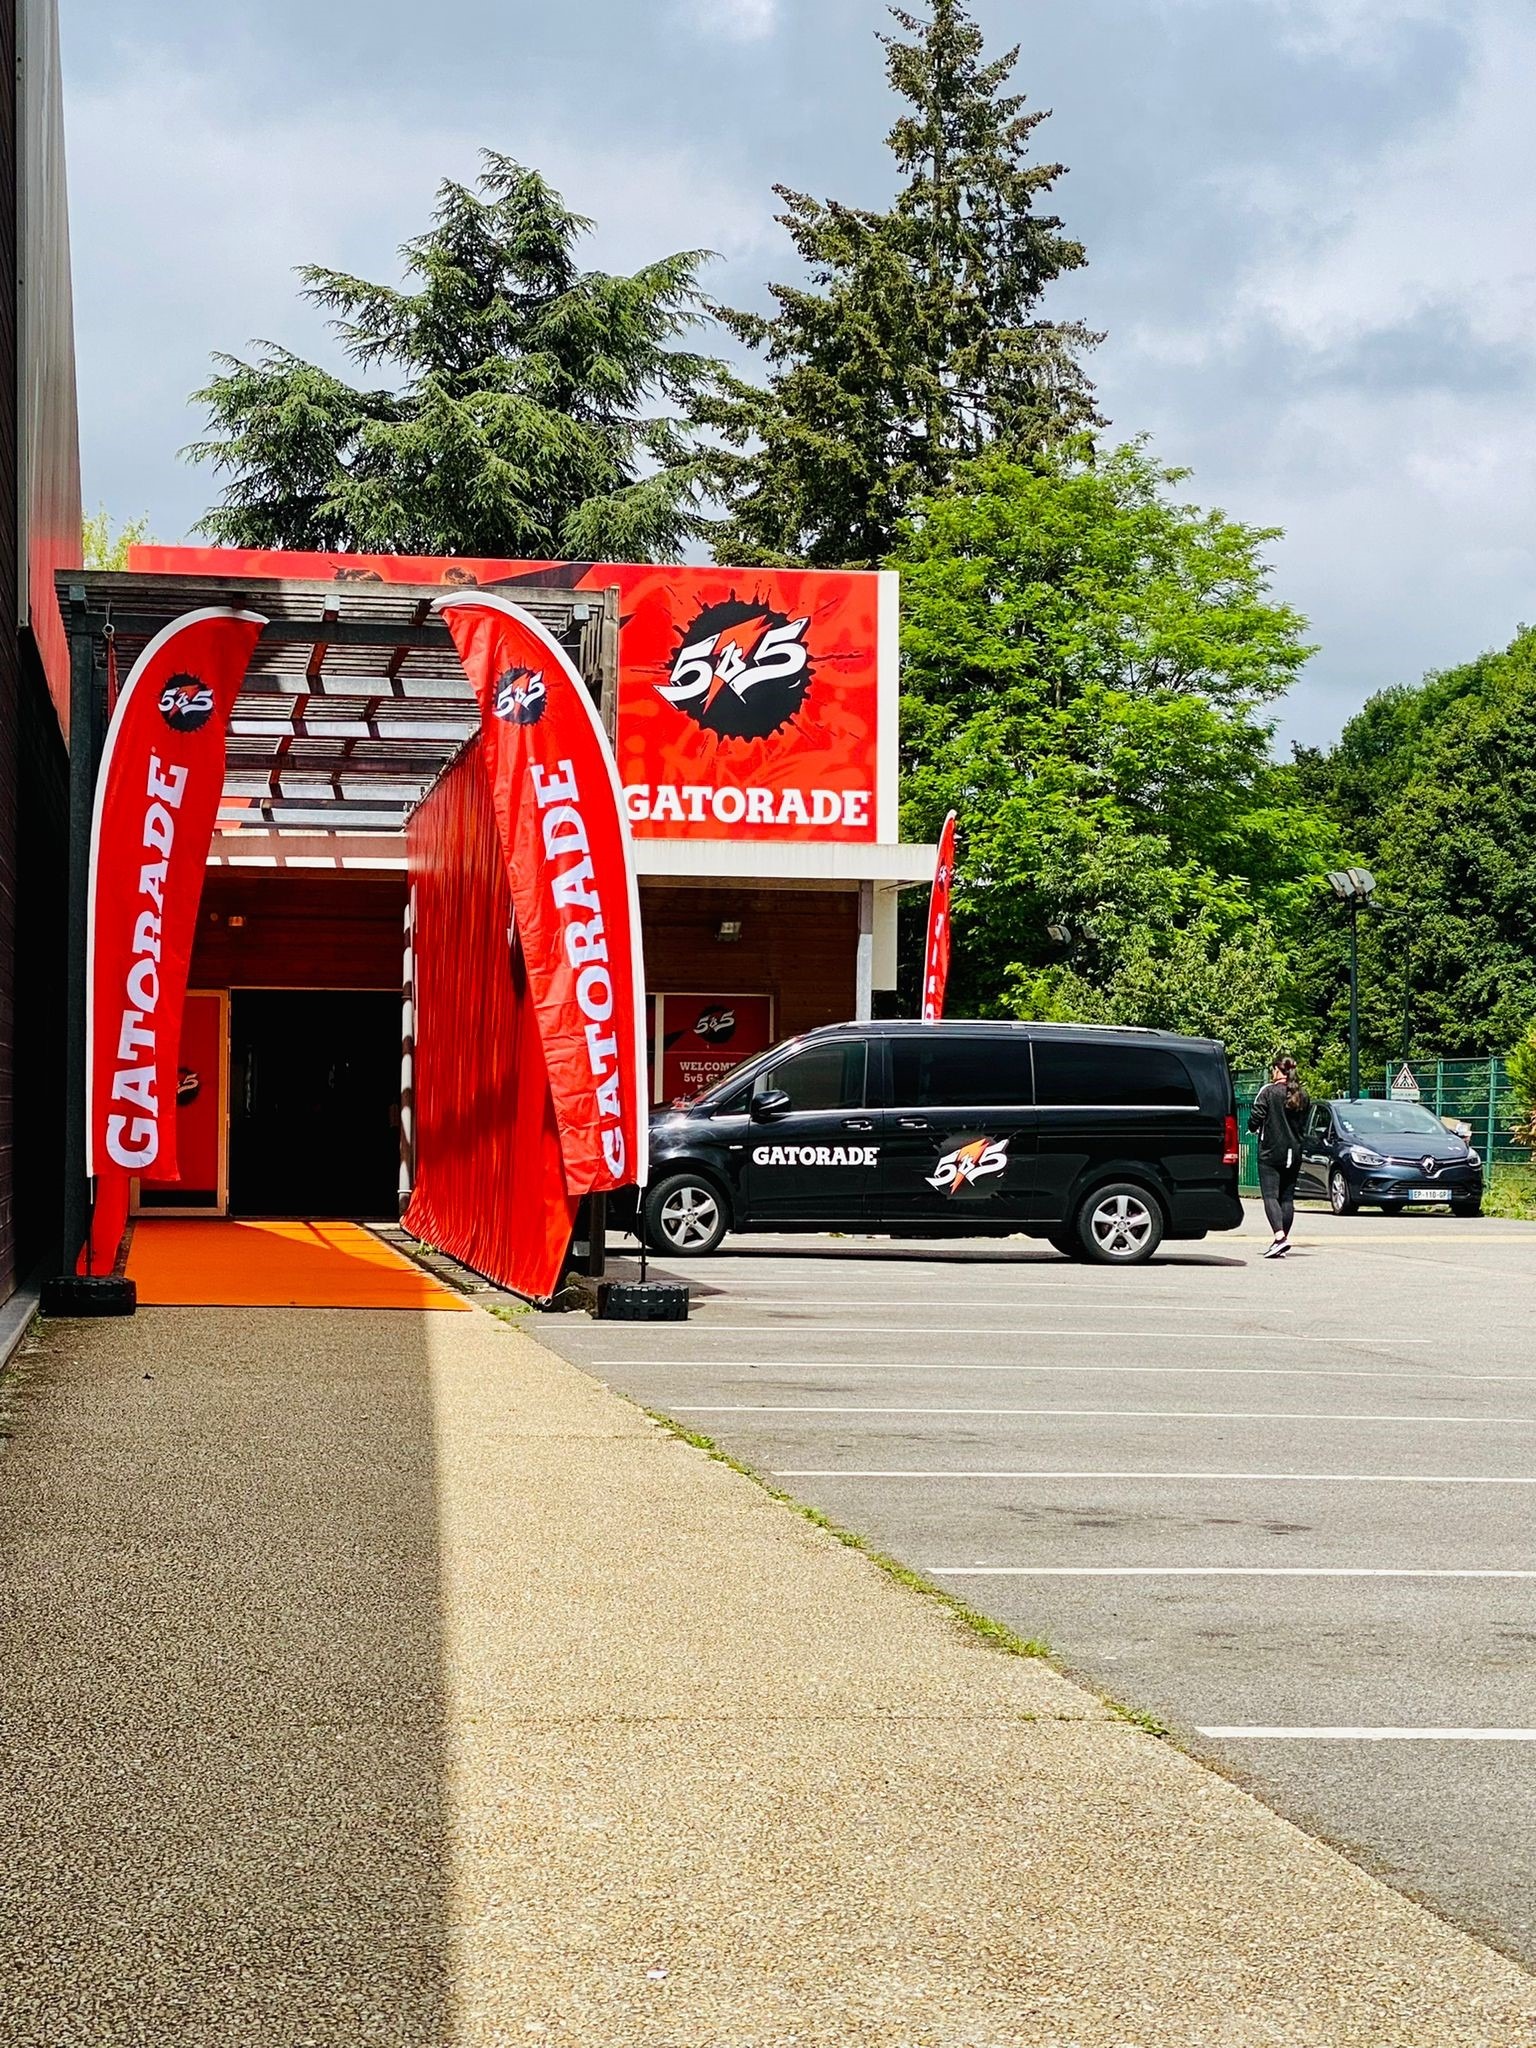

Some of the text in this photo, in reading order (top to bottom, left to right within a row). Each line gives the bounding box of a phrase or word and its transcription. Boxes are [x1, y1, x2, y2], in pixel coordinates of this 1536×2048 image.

[622, 783, 869, 827] GATORADE
[106, 754, 189, 1169] GATORADE
[530, 758, 626, 1179] GATORADE
[752, 1146, 880, 1167] GATORADE
